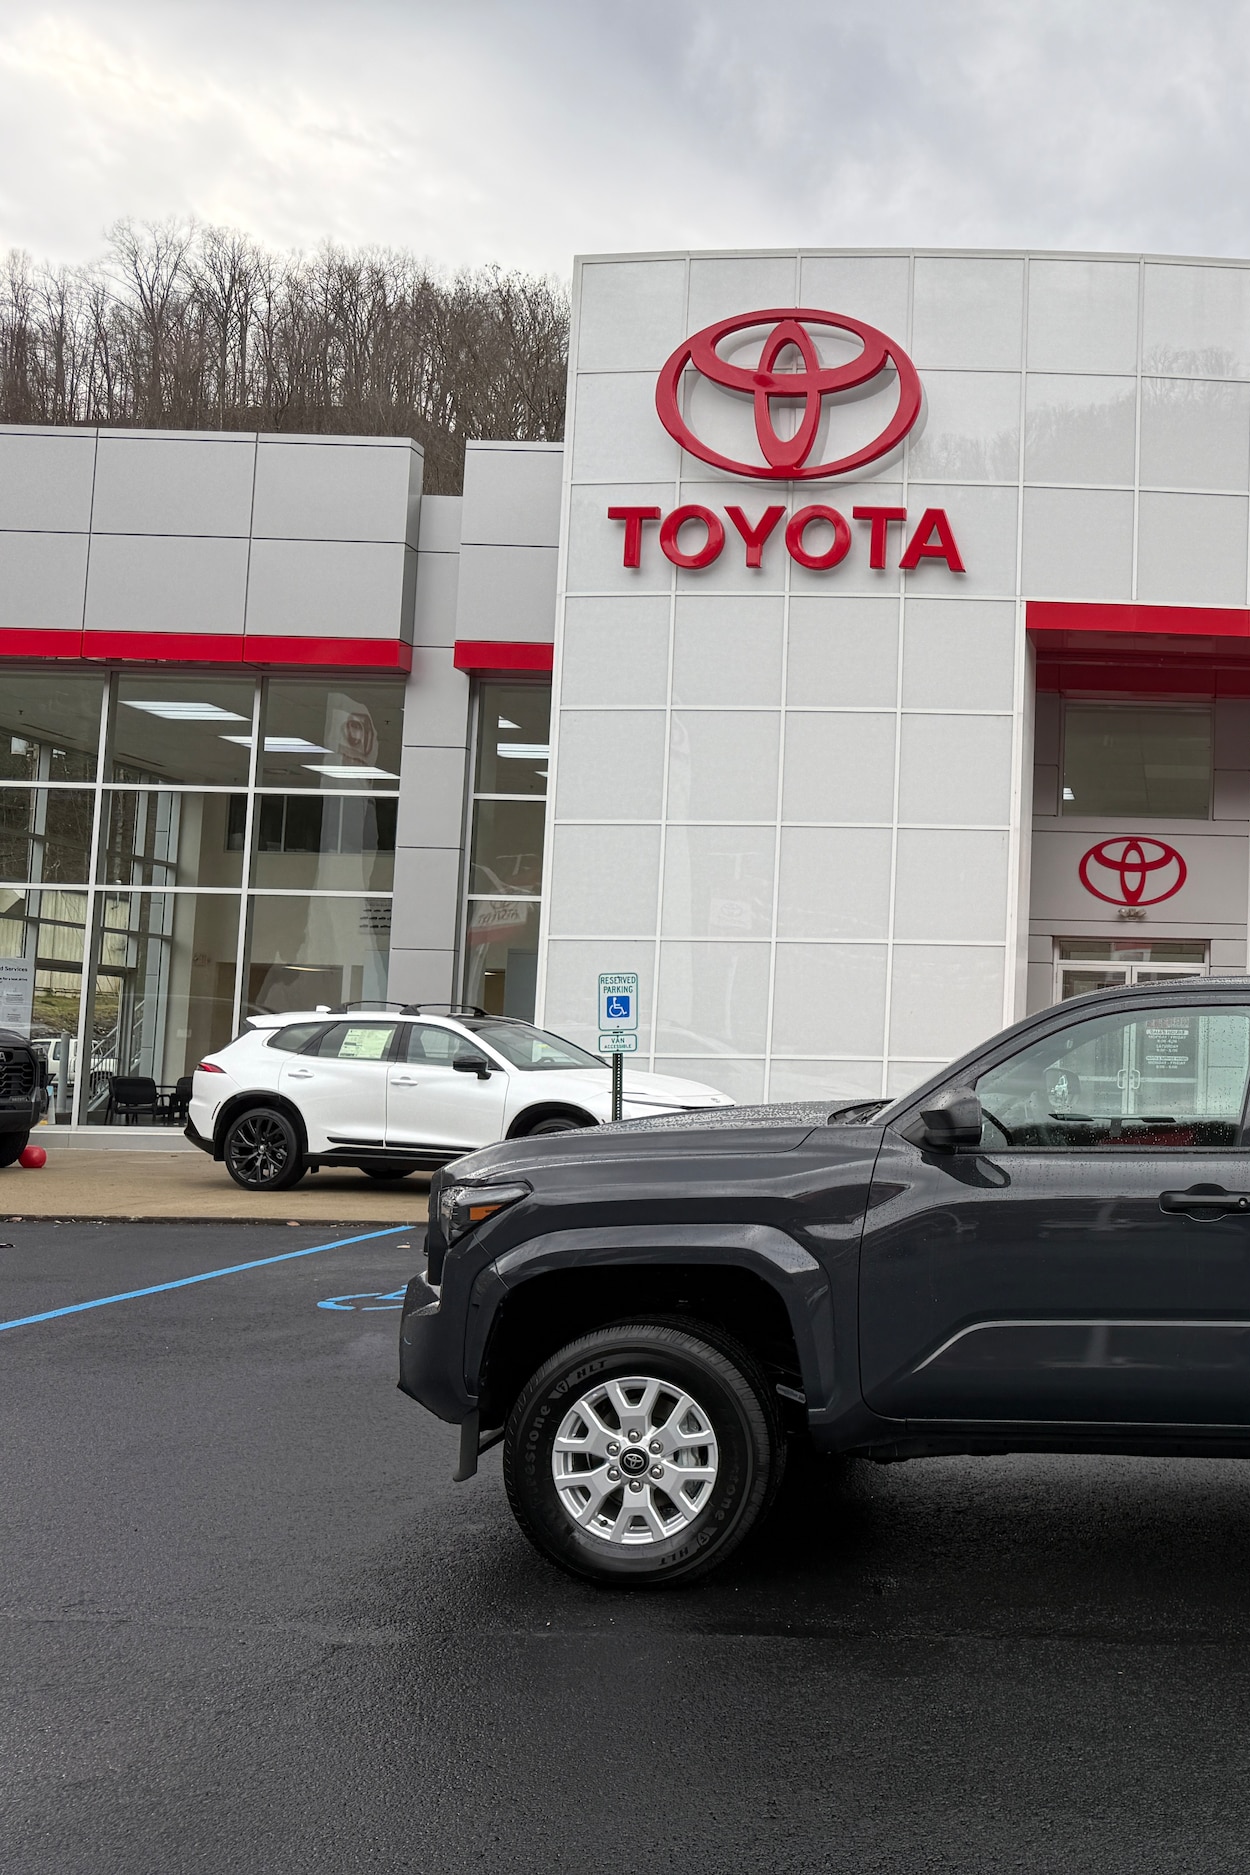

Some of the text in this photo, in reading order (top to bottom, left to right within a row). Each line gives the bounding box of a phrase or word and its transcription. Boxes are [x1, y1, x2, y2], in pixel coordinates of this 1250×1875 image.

[608, 504, 967, 573] TOYOTA
[600, 976, 636, 985] RESERVED
[603, 985, 634, 994] PARKING
[576, 1359, 608, 1380] HLT
